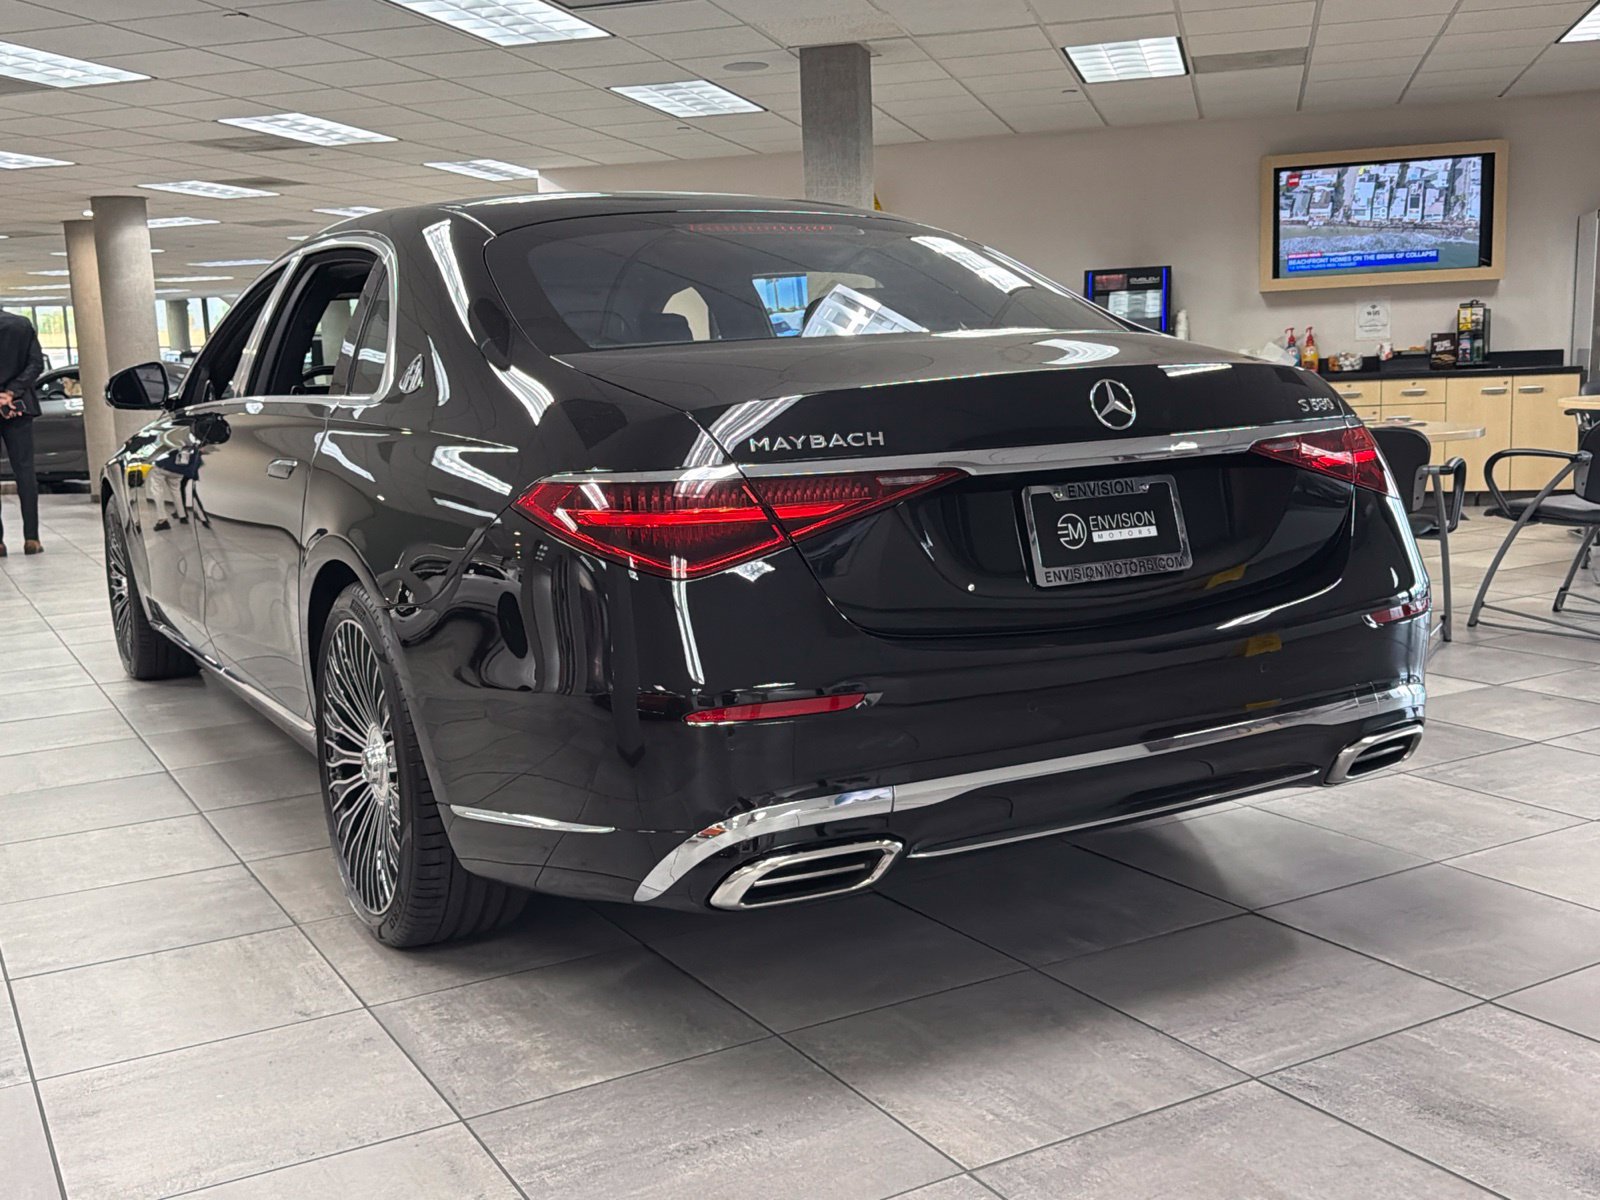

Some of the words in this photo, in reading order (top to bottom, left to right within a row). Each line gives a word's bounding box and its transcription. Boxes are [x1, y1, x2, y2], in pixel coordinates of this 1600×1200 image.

[1288, 257, 1329, 266] BEACHFRONT
[1405, 250, 1437, 259] COLLAPSE
[1297, 398, 1310, 412] S
[749, 431, 885, 452] MAYBACH
[1067, 479, 1135, 498] ENVISION
[1089, 510, 1156, 531] ENVISION
[1097, 529, 1152, 539] MOTORS
[1045, 556, 1184, 583] ENVISIONMOTORS.COM
